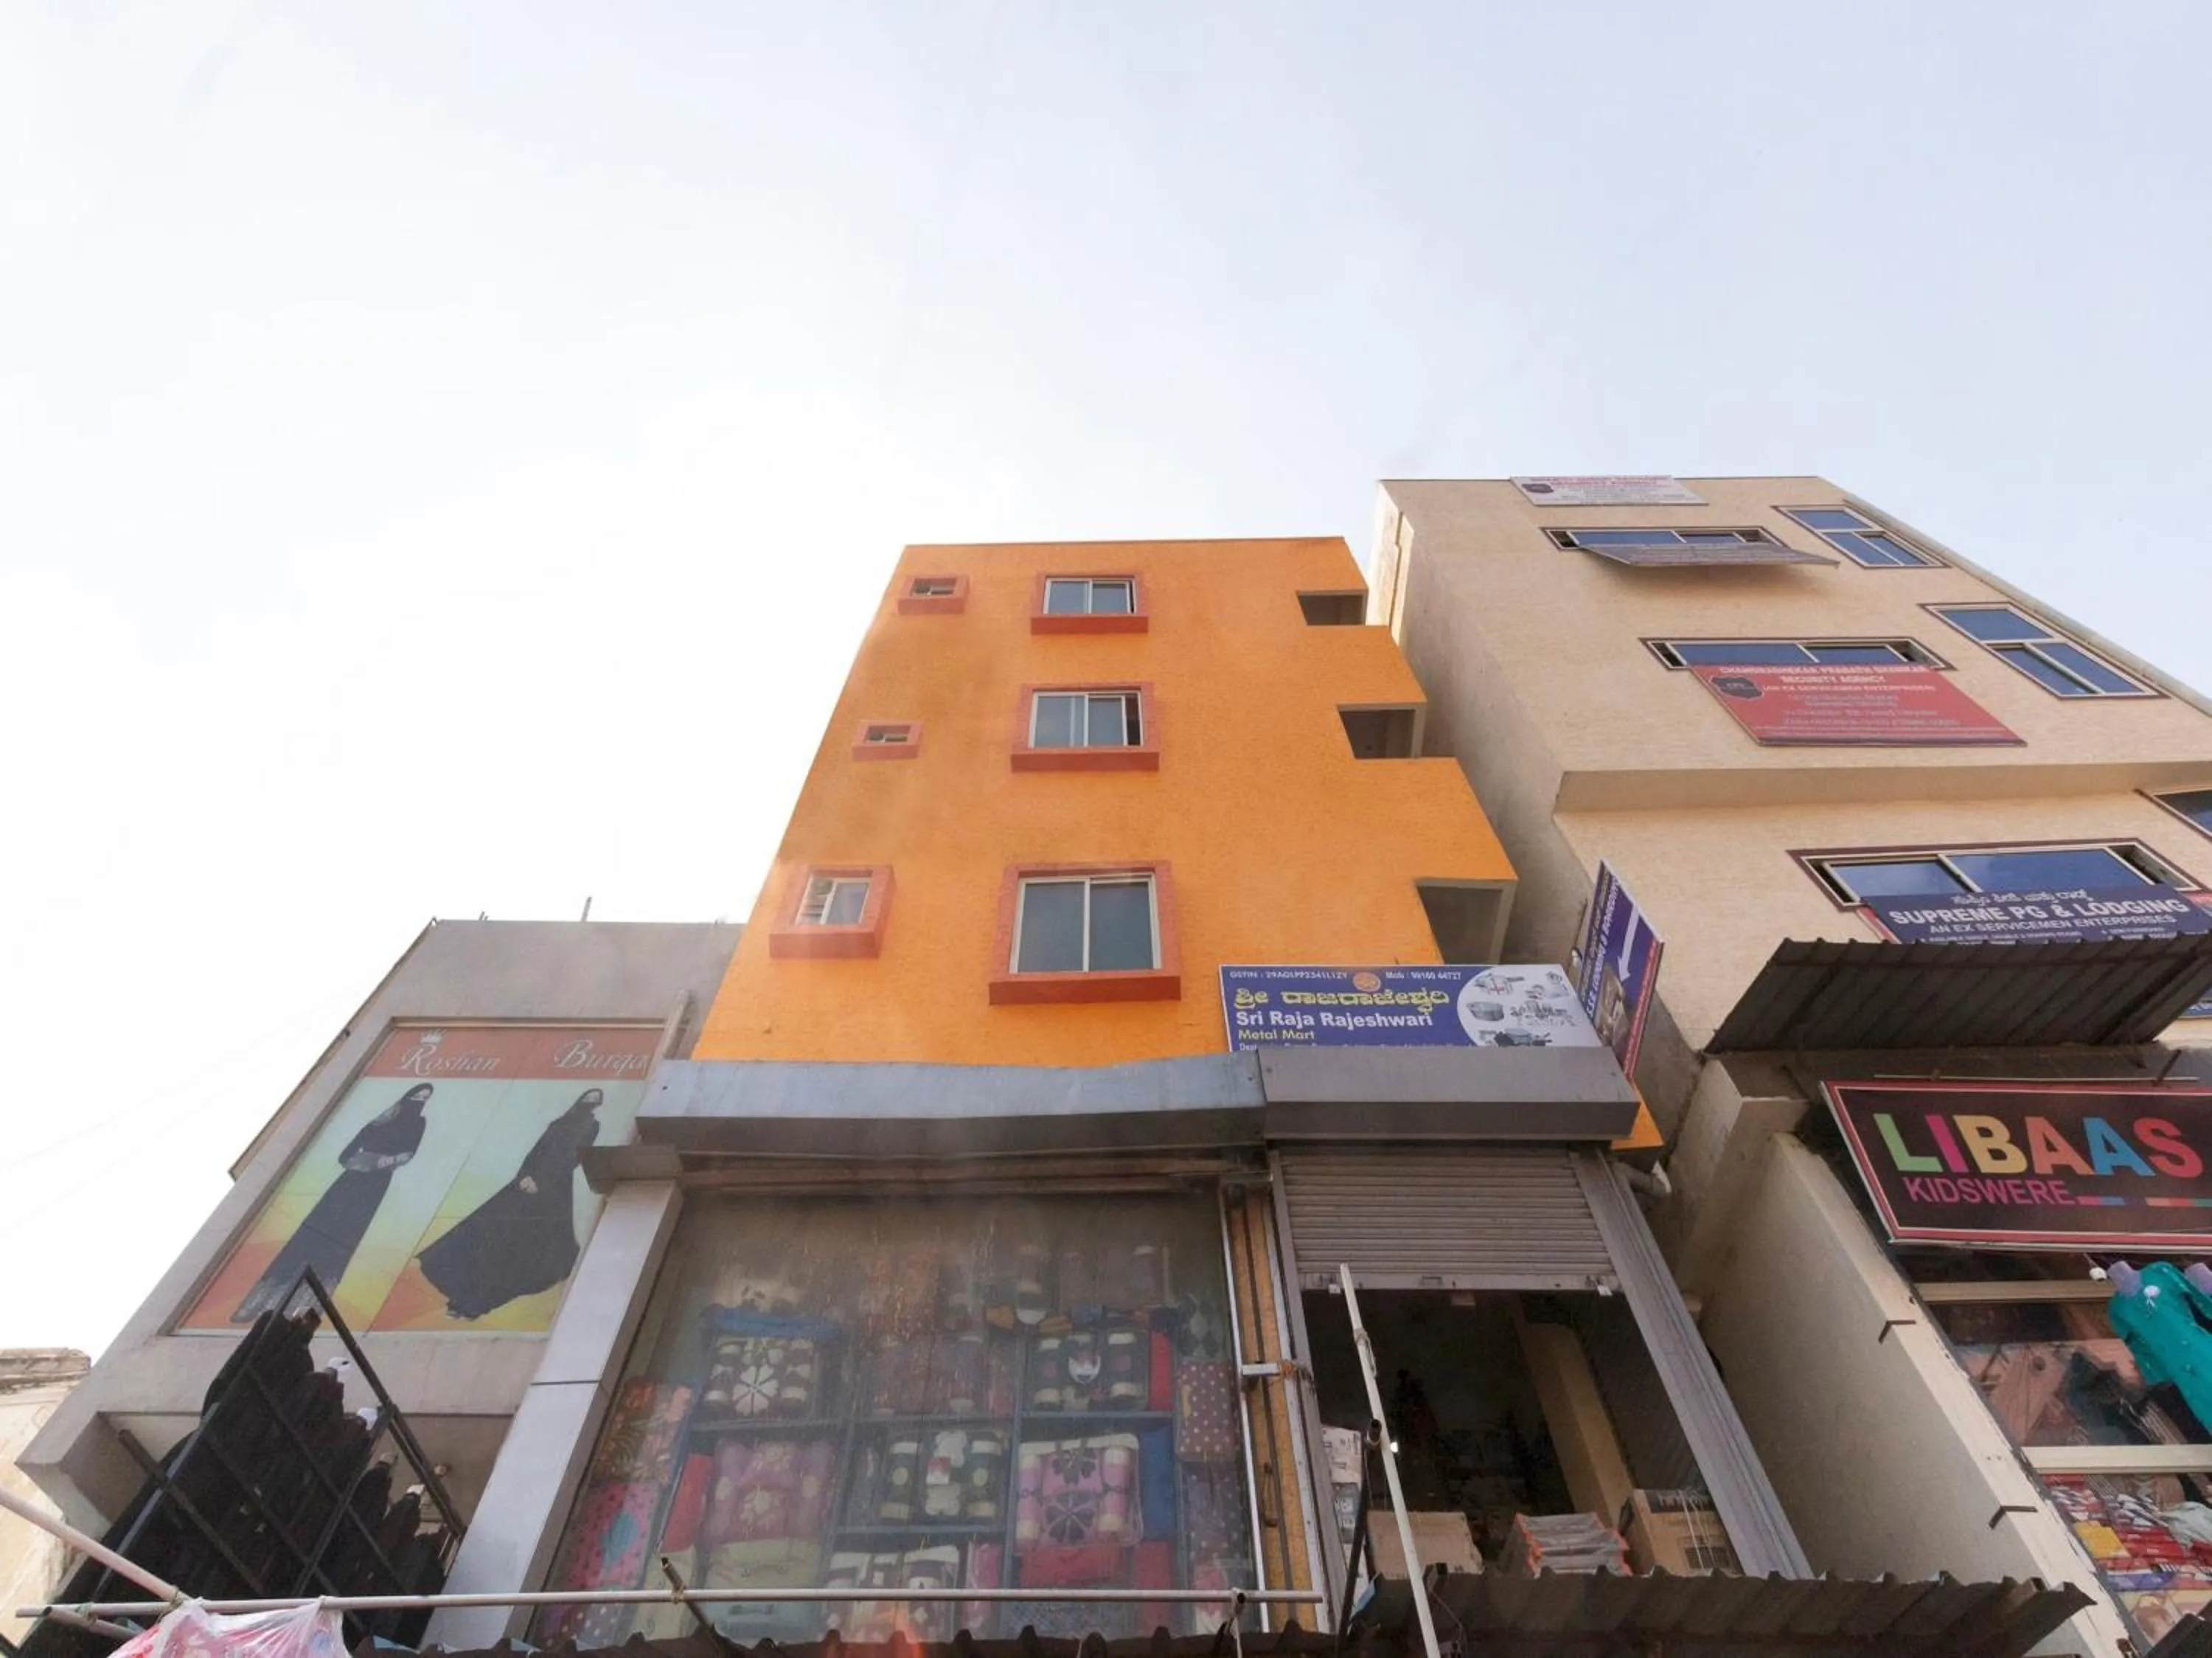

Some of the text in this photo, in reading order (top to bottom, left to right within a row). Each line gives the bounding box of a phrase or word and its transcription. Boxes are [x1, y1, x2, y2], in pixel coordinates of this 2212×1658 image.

[1888, 906, 2010, 924] SUPREME
[2008, 905, 2048, 920] PG
[2051, 903, 2075, 918] &
[2073, 899, 2191, 917] LODGING
[1930, 924, 1950, 934] AN
[1975, 919, 2071, 932] SERVICEMEN
[2073, 915, 2177, 927] ENTERPRISES
[1236, 1010, 1434, 1031] Sri Raja Rajeshwari
[1238, 1029, 1315, 1040] Metal Mart
[400, 1042, 501, 1077] Roshan
[1873, 1112, 2204, 1179] LIBAAS
[1901, 1176, 2079, 1205] KIDSWERE
